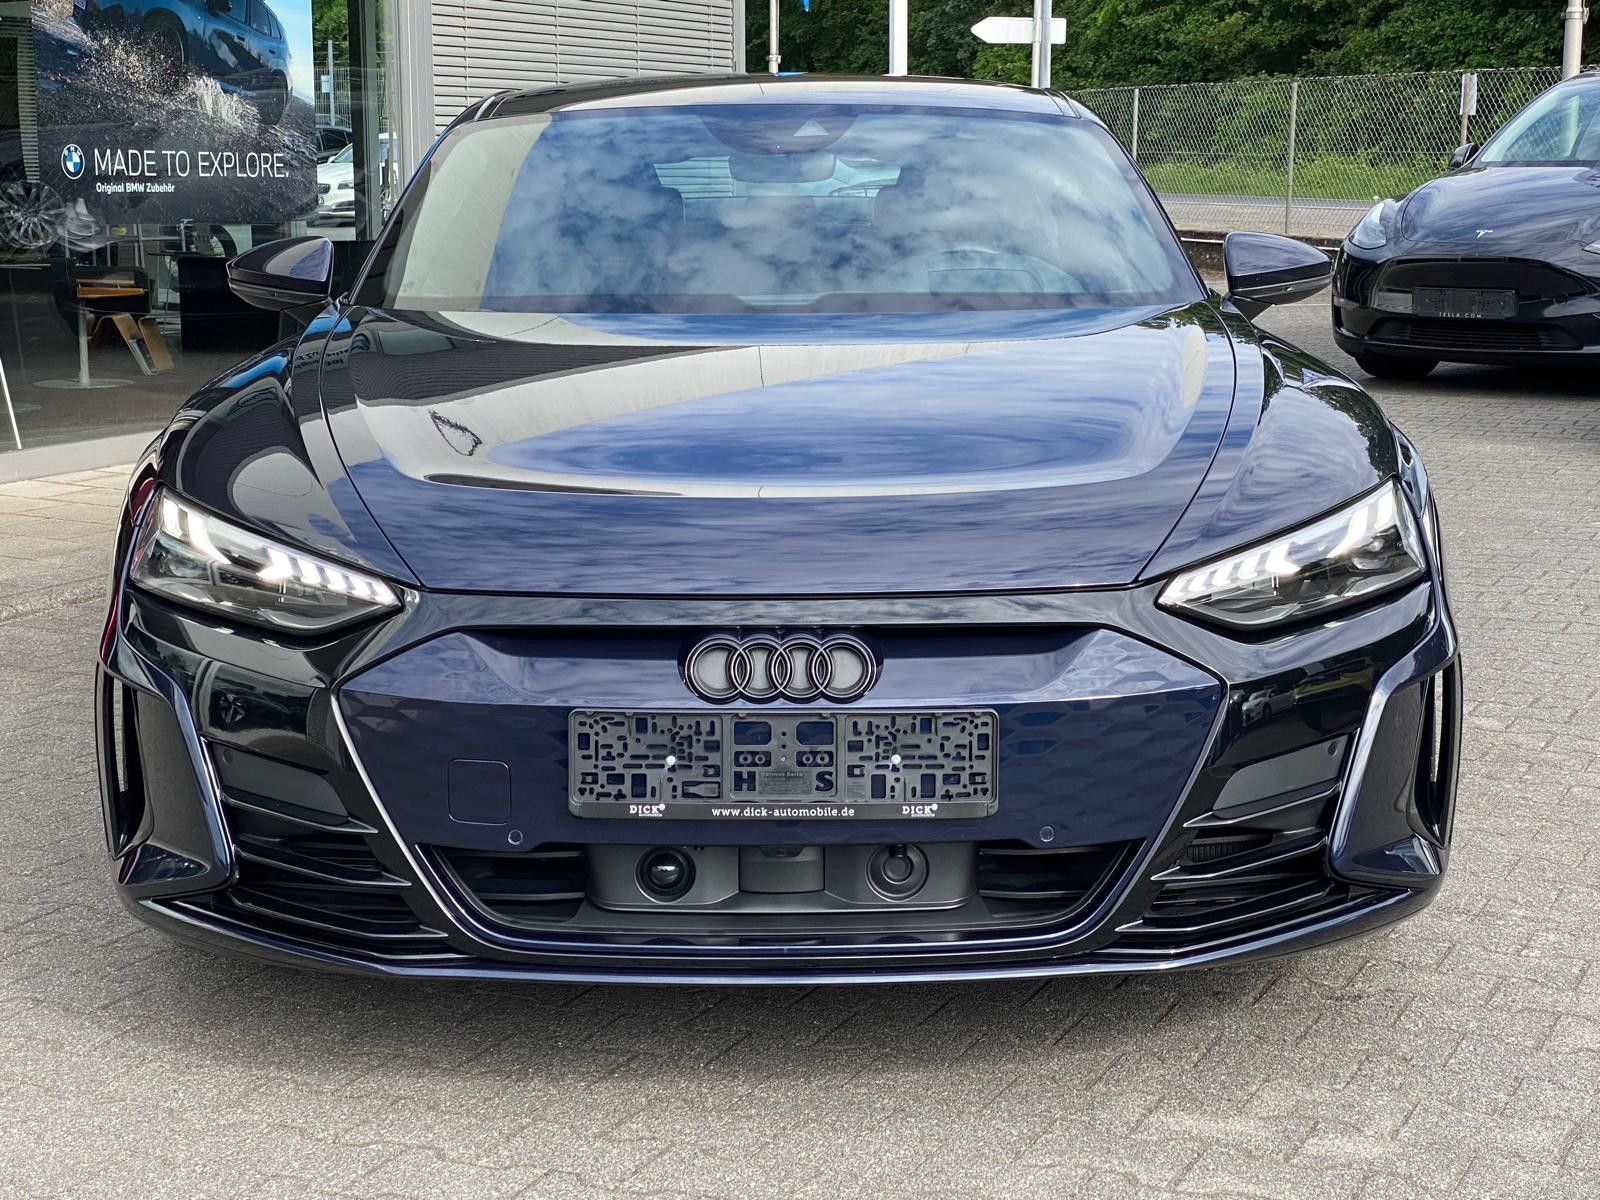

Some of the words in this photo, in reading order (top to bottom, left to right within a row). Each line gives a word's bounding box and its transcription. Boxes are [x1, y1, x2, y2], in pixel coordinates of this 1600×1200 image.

[94, 148, 157, 176] MADE
[162, 150, 190, 177] TO
[198, 151, 289, 178] EXPLORE.
[96, 182, 124, 195] Original
[125, 183, 145, 193] BMW
[146, 183, 175, 193] Zubehör
[629, 804, 660, 814] DICK
[711, 807, 855, 816] www.dick-automobile.de
[902, 805, 932, 814] DICK
